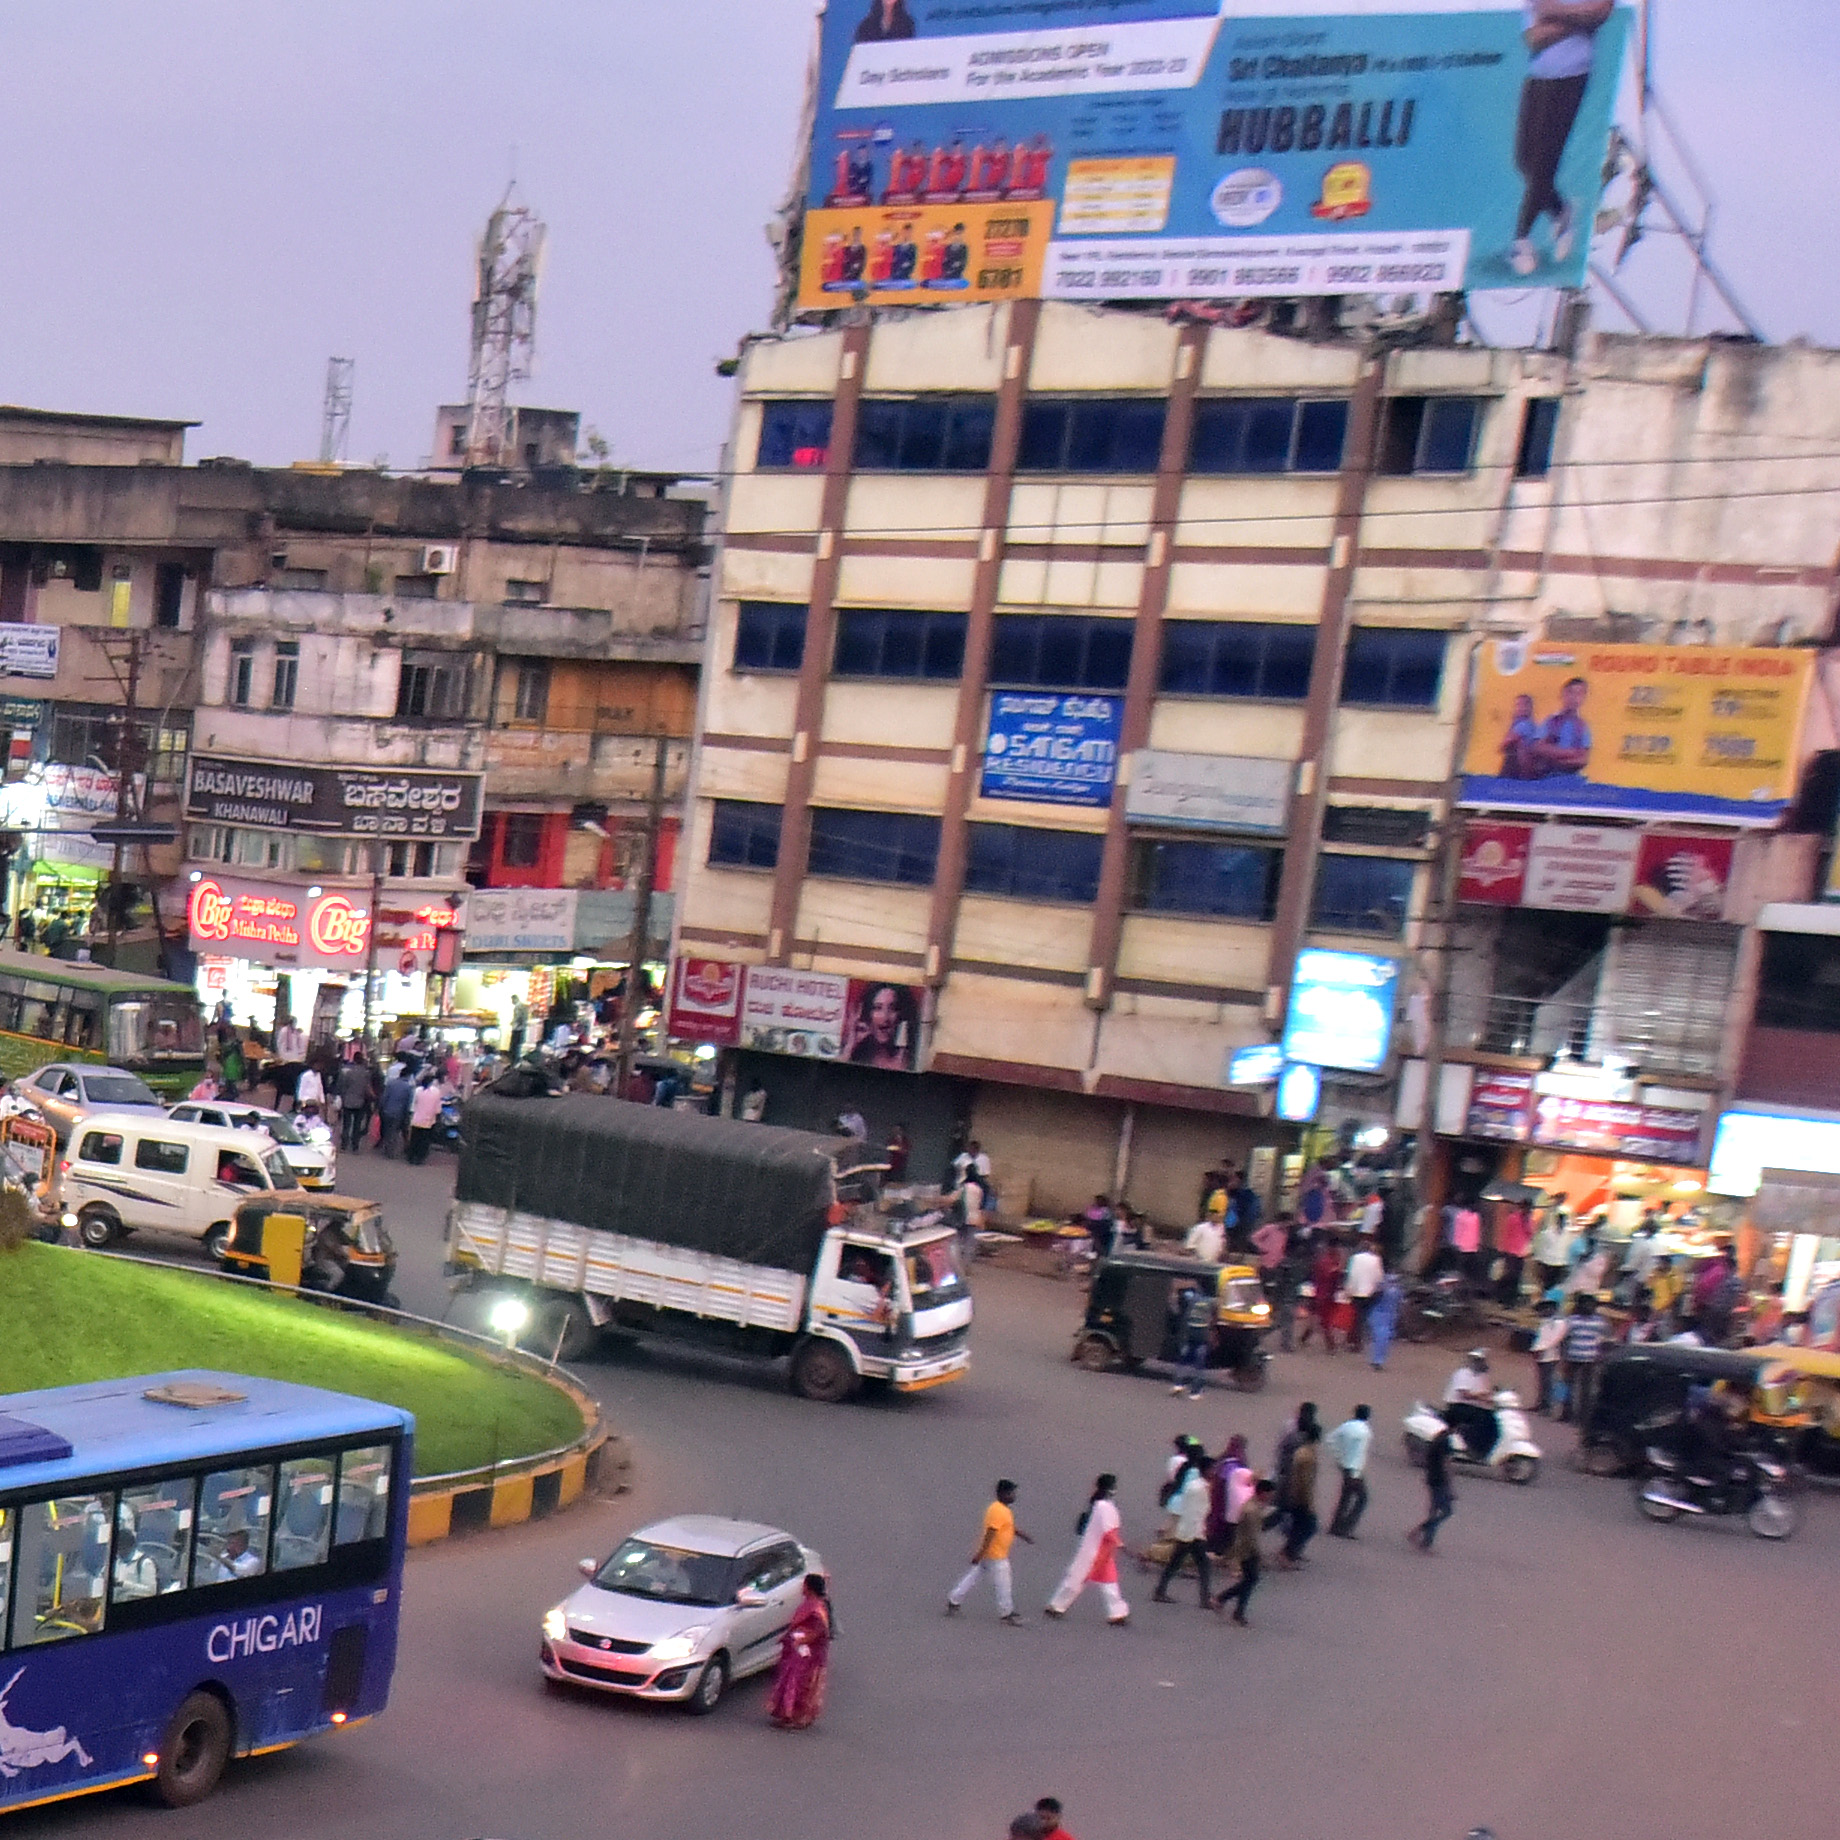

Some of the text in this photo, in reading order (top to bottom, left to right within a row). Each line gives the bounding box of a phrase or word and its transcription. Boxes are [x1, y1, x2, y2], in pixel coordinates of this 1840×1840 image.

[1216, 99, 1417, 155] HUBBALLI
[1588, 655, 1795, 677] ROUND TABLE INDIA
[194, 770, 314, 804] BASAVESHWAR
[342, 779, 462, 815] ಬಸವೇಶ್ವರ
[215, 803, 288, 825] KHANAWALI
[202, 893, 233, 940] Big
[232, 919, 299, 945] Mishra Pedha
[324, 907, 370, 954] Big
[795, 979, 841, 999] HOTEL
[207, 1603, 323, 1662] CHIGARI
